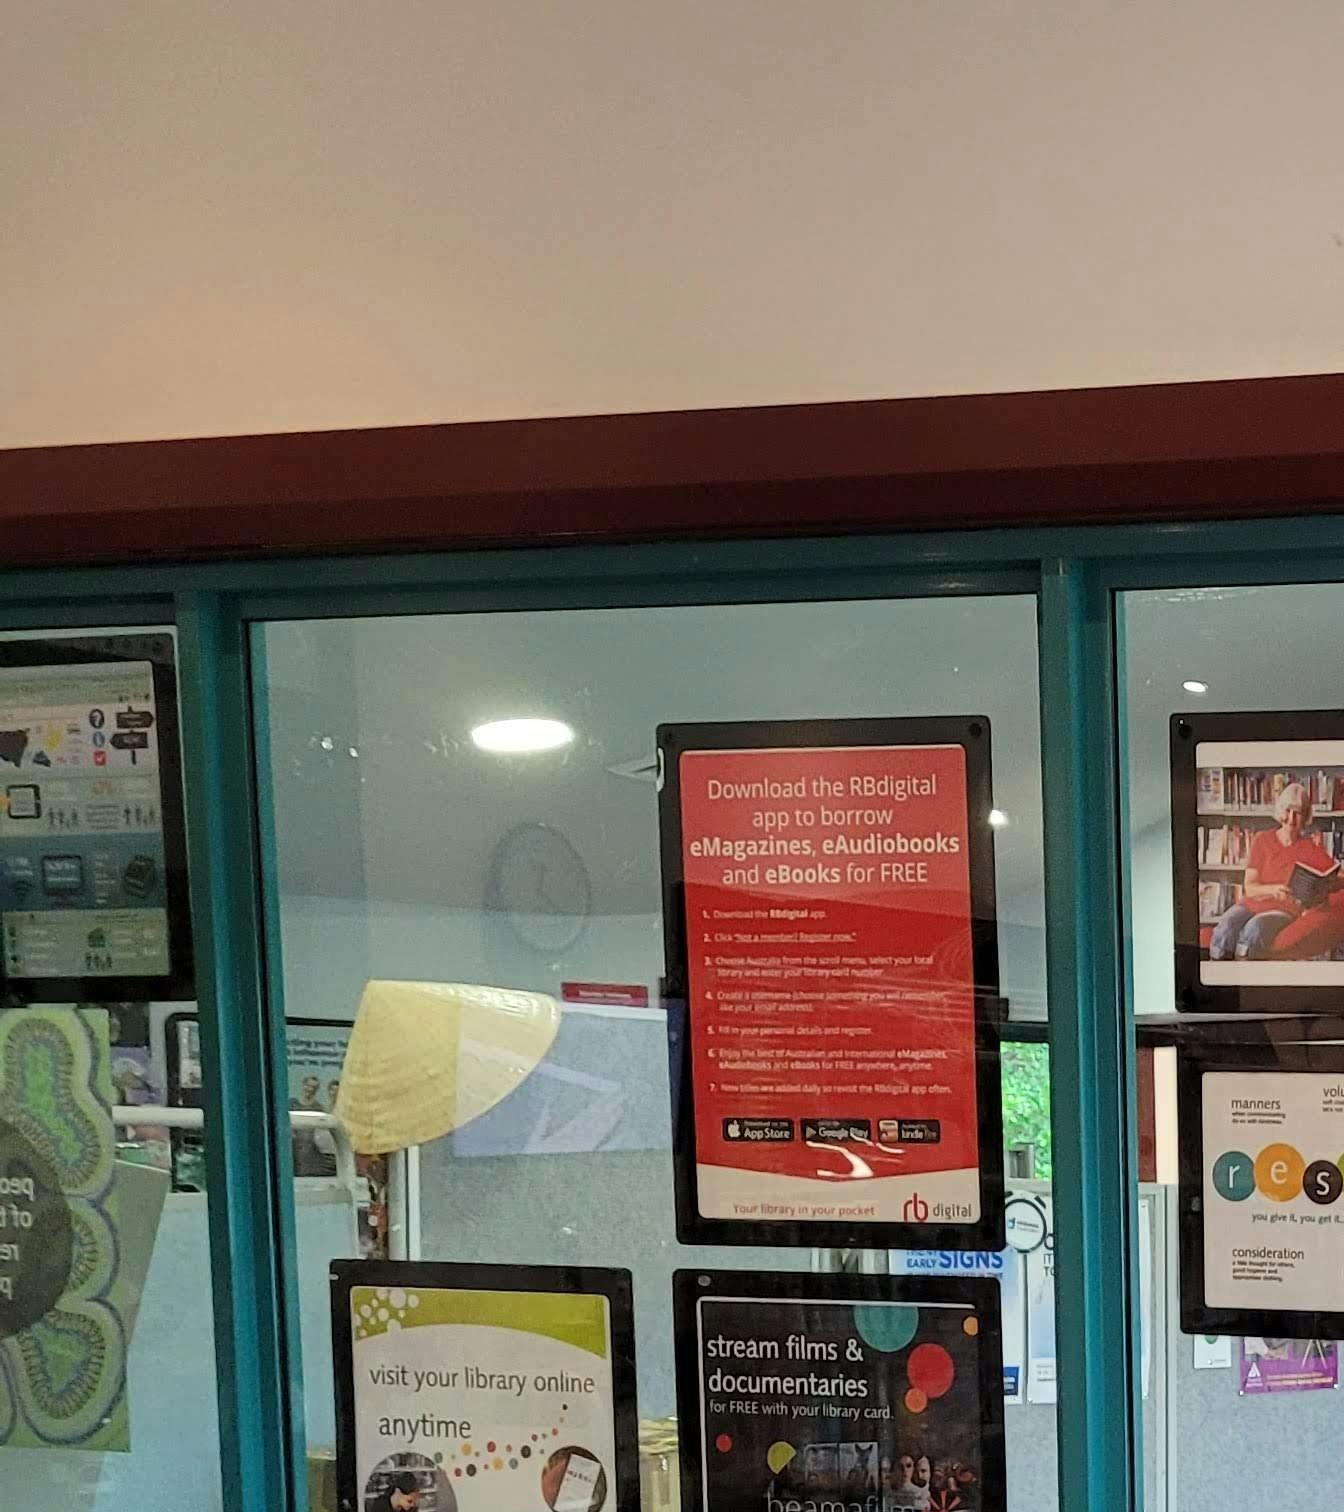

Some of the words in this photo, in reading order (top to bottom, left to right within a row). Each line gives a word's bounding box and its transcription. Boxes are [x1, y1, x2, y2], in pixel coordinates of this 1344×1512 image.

[708, 778, 806, 800] Download
[813, 777, 844, 798] the
[850, 775, 936, 800] RBdigital
[753, 808, 790, 831] app
[796, 807, 815, 826] to
[821, 805, 893, 825] borrow
[690, 837, 816, 863] eMagazines,
[822, 833, 959, 855] eAudiobooks
[722, 864, 760, 885] and
[765, 864, 841, 884] eBooks
[847, 863, 875, 883] for
[881, 863, 928, 882] FREE
[1231, 1098, 1281, 1110] manners
[761, 1203, 796, 1218] library
[799, 1204, 808, 1215] in
[811, 1205, 836, 1218] your
[839, 1203, 875, 1218] pocket
[933, 1204, 972, 1220] digital
[1252, 1214, 1268, 1224] you
[1270, 1213, 1287, 1224] give
[1300, 1215, 1316, 1226] you
[1318, 1214, 1332, 1225] get
[906, 1257, 937, 1269] EARLY
[939, 1251, 1004, 1269] SIGNS
[1232, 1247, 1305, 1260] consideration
[707, 1335, 780, 1360] stream
[786, 1335, 838, 1361] films
[846, 1338, 864, 1361] &
[370, 1365, 408, 1386] visit
[415, 1370, 458, 1392] your
[465, 1366, 527, 1397] library
[534, 1370, 595, 1393] online
[708, 1368, 868, 1398] documentaries
[709, 1400, 727, 1413] for
[729, 1401, 759, 1415] FREE
[762, 1402, 788, 1416] with
[791, 1404, 820, 1420] your
[822, 1403, 860, 1421] library
[864, 1404, 895, 1420] card.
[379, 1413, 472, 1443] anytime
